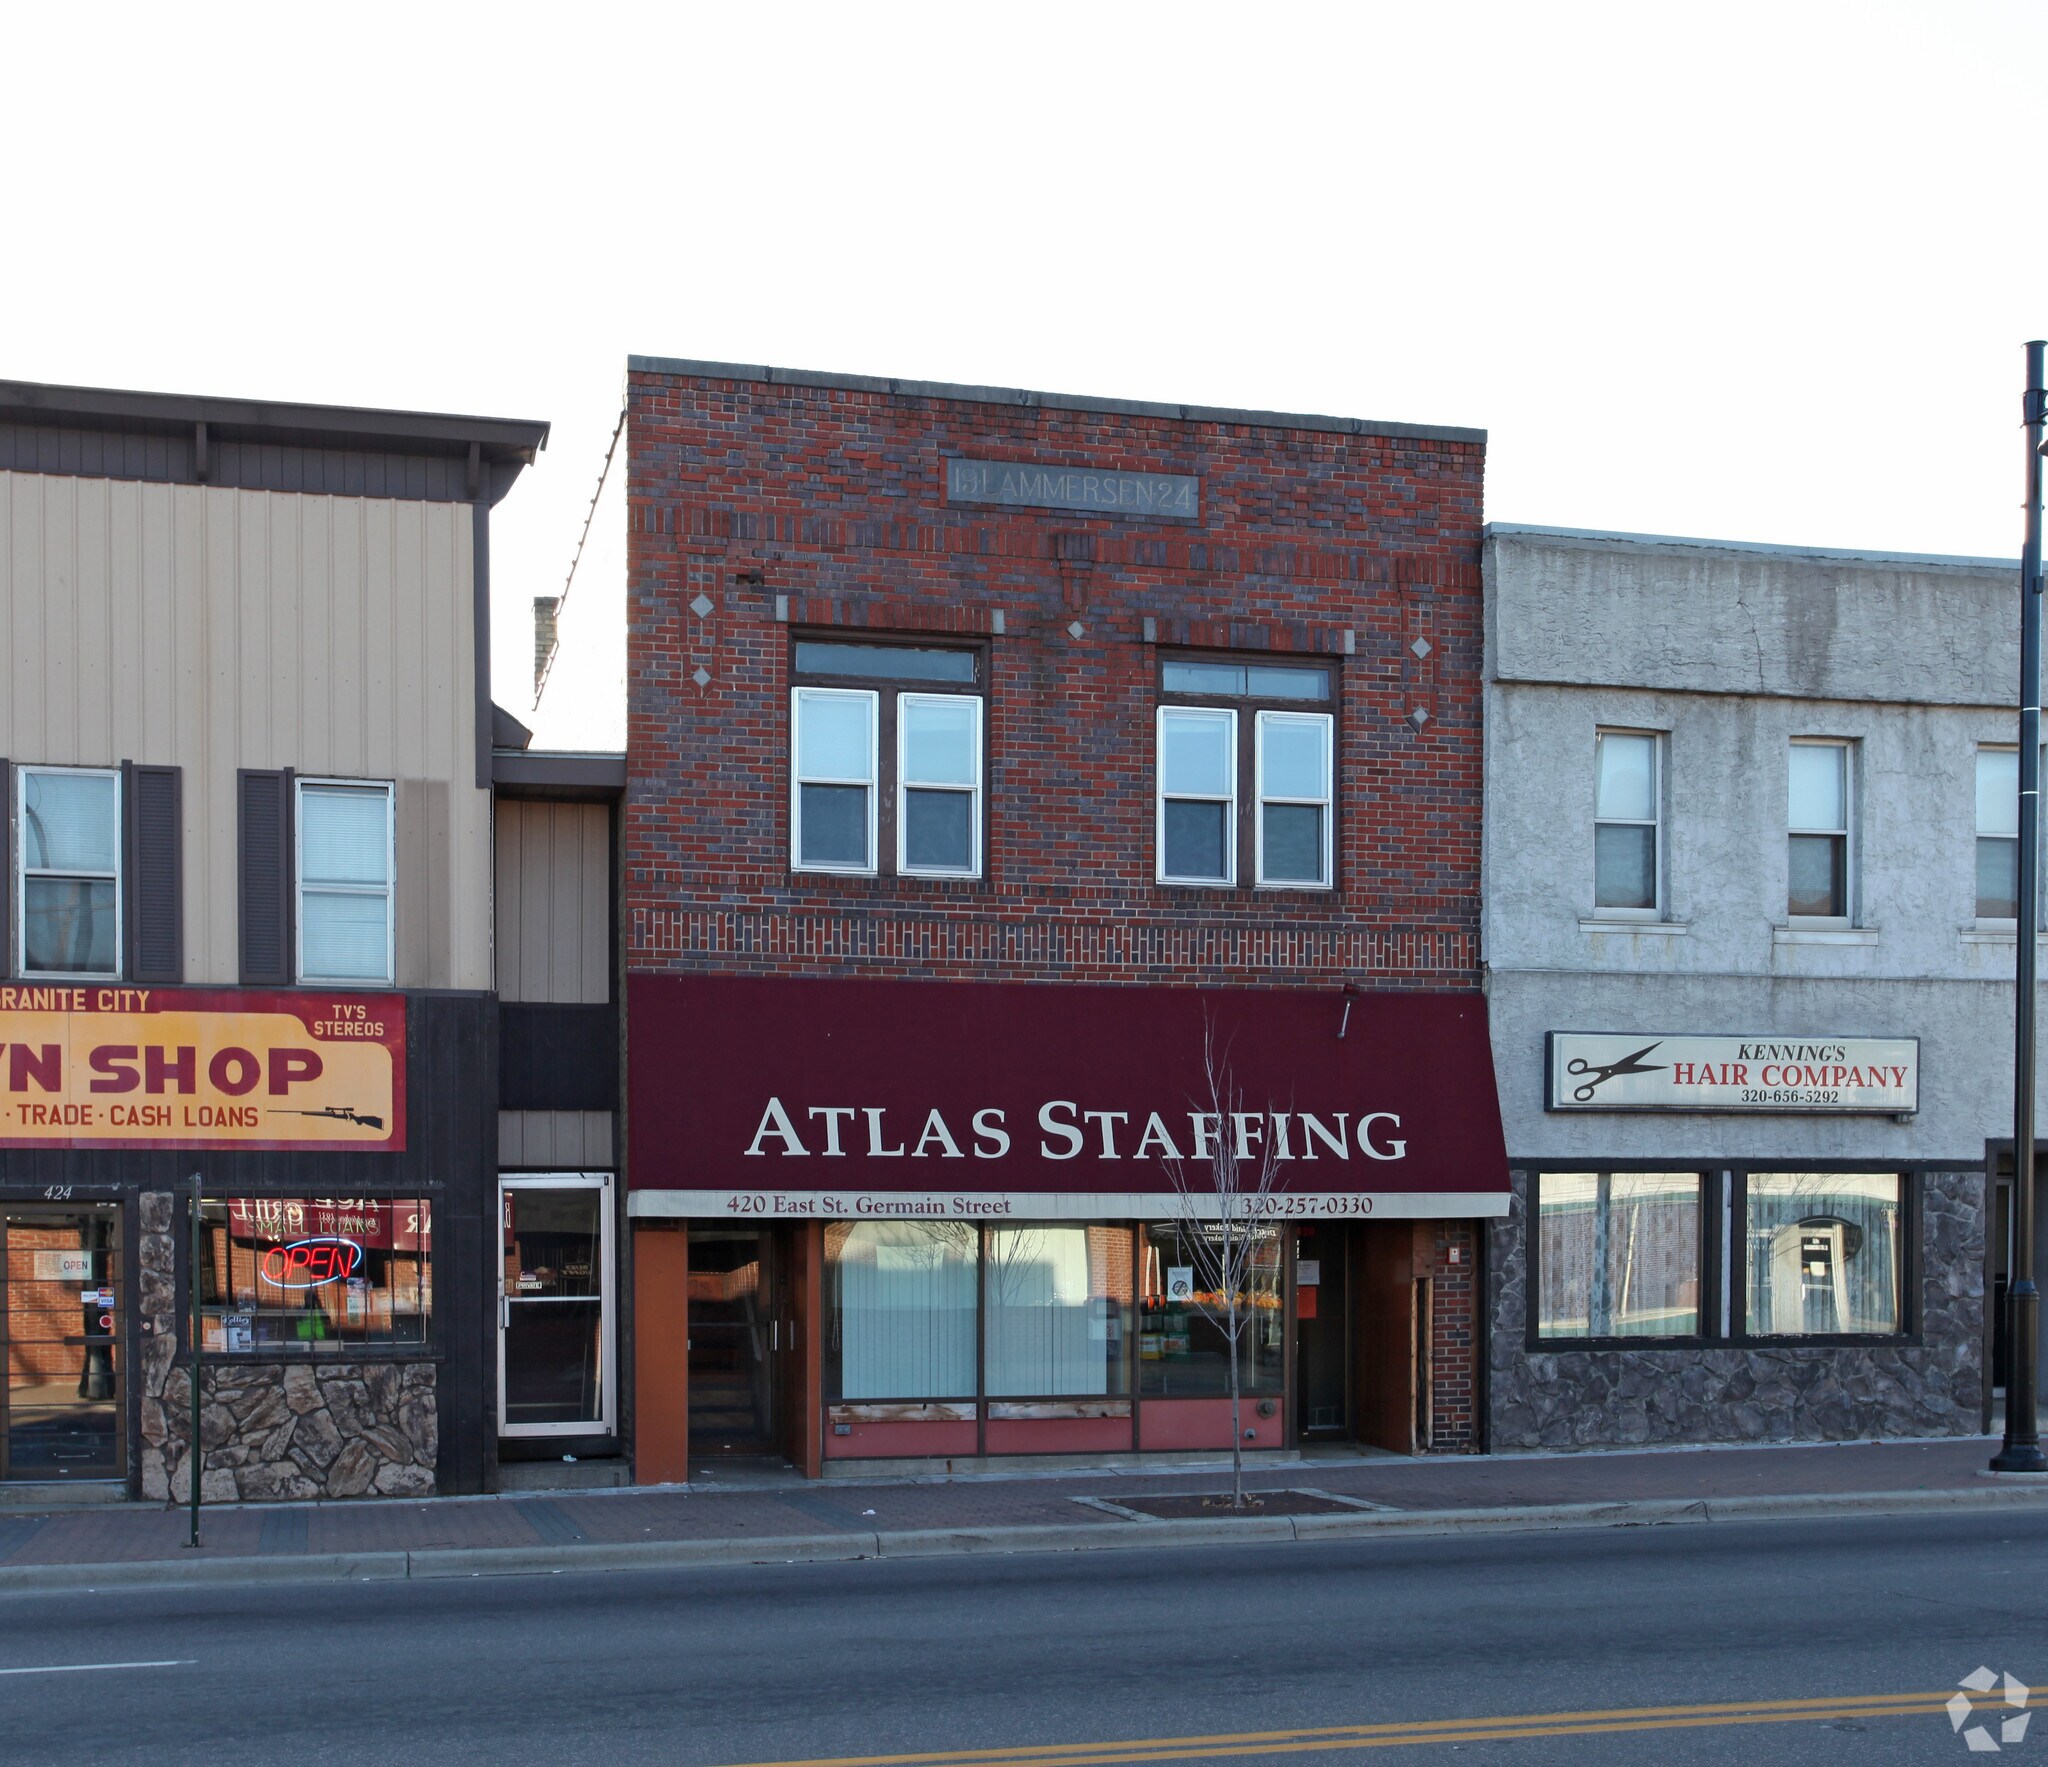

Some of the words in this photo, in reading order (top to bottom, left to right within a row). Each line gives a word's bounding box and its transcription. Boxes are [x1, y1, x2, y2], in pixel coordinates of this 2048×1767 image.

[0, 987, 86, 1010] RANITE
[98, 989, 150, 1011] CITY
[332, 1004, 367, 1019] TV'S
[313, 1020, 385, 1037] STEREOS
[1736, 1043, 1847, 1062] KENNING'S
[0, 1043, 62, 1092] N
[88, 1045, 324, 1096] SHOP
[1673, 1062, 1749, 1086] HAIR
[1761, 1064, 1908, 1089] COMPANY
[1741, 1088, 1839, 1104] 320-656-5292
[17, 1103, 93, 1126] TRADE
[110, 1105, 172, 1127] CASH
[184, 1106, 259, 1128] LOANS
[744, 1096, 1011, 1159] ATLAS
[44, 1185, 73, 1200] 424
[727, 1195, 766, 1213] 420
[773, 1195, 815, 1213] East
[822, 1196, 848, 1214] St.
[856, 1196, 946, 1214] Germain
[952, 1196, 1012, 1214] Street
[1242, 1197, 1373, 1214] 320-257-0330
[63, 1260, 88, 1270] OPEN
[262, 1246, 354, 1279] OPEN
